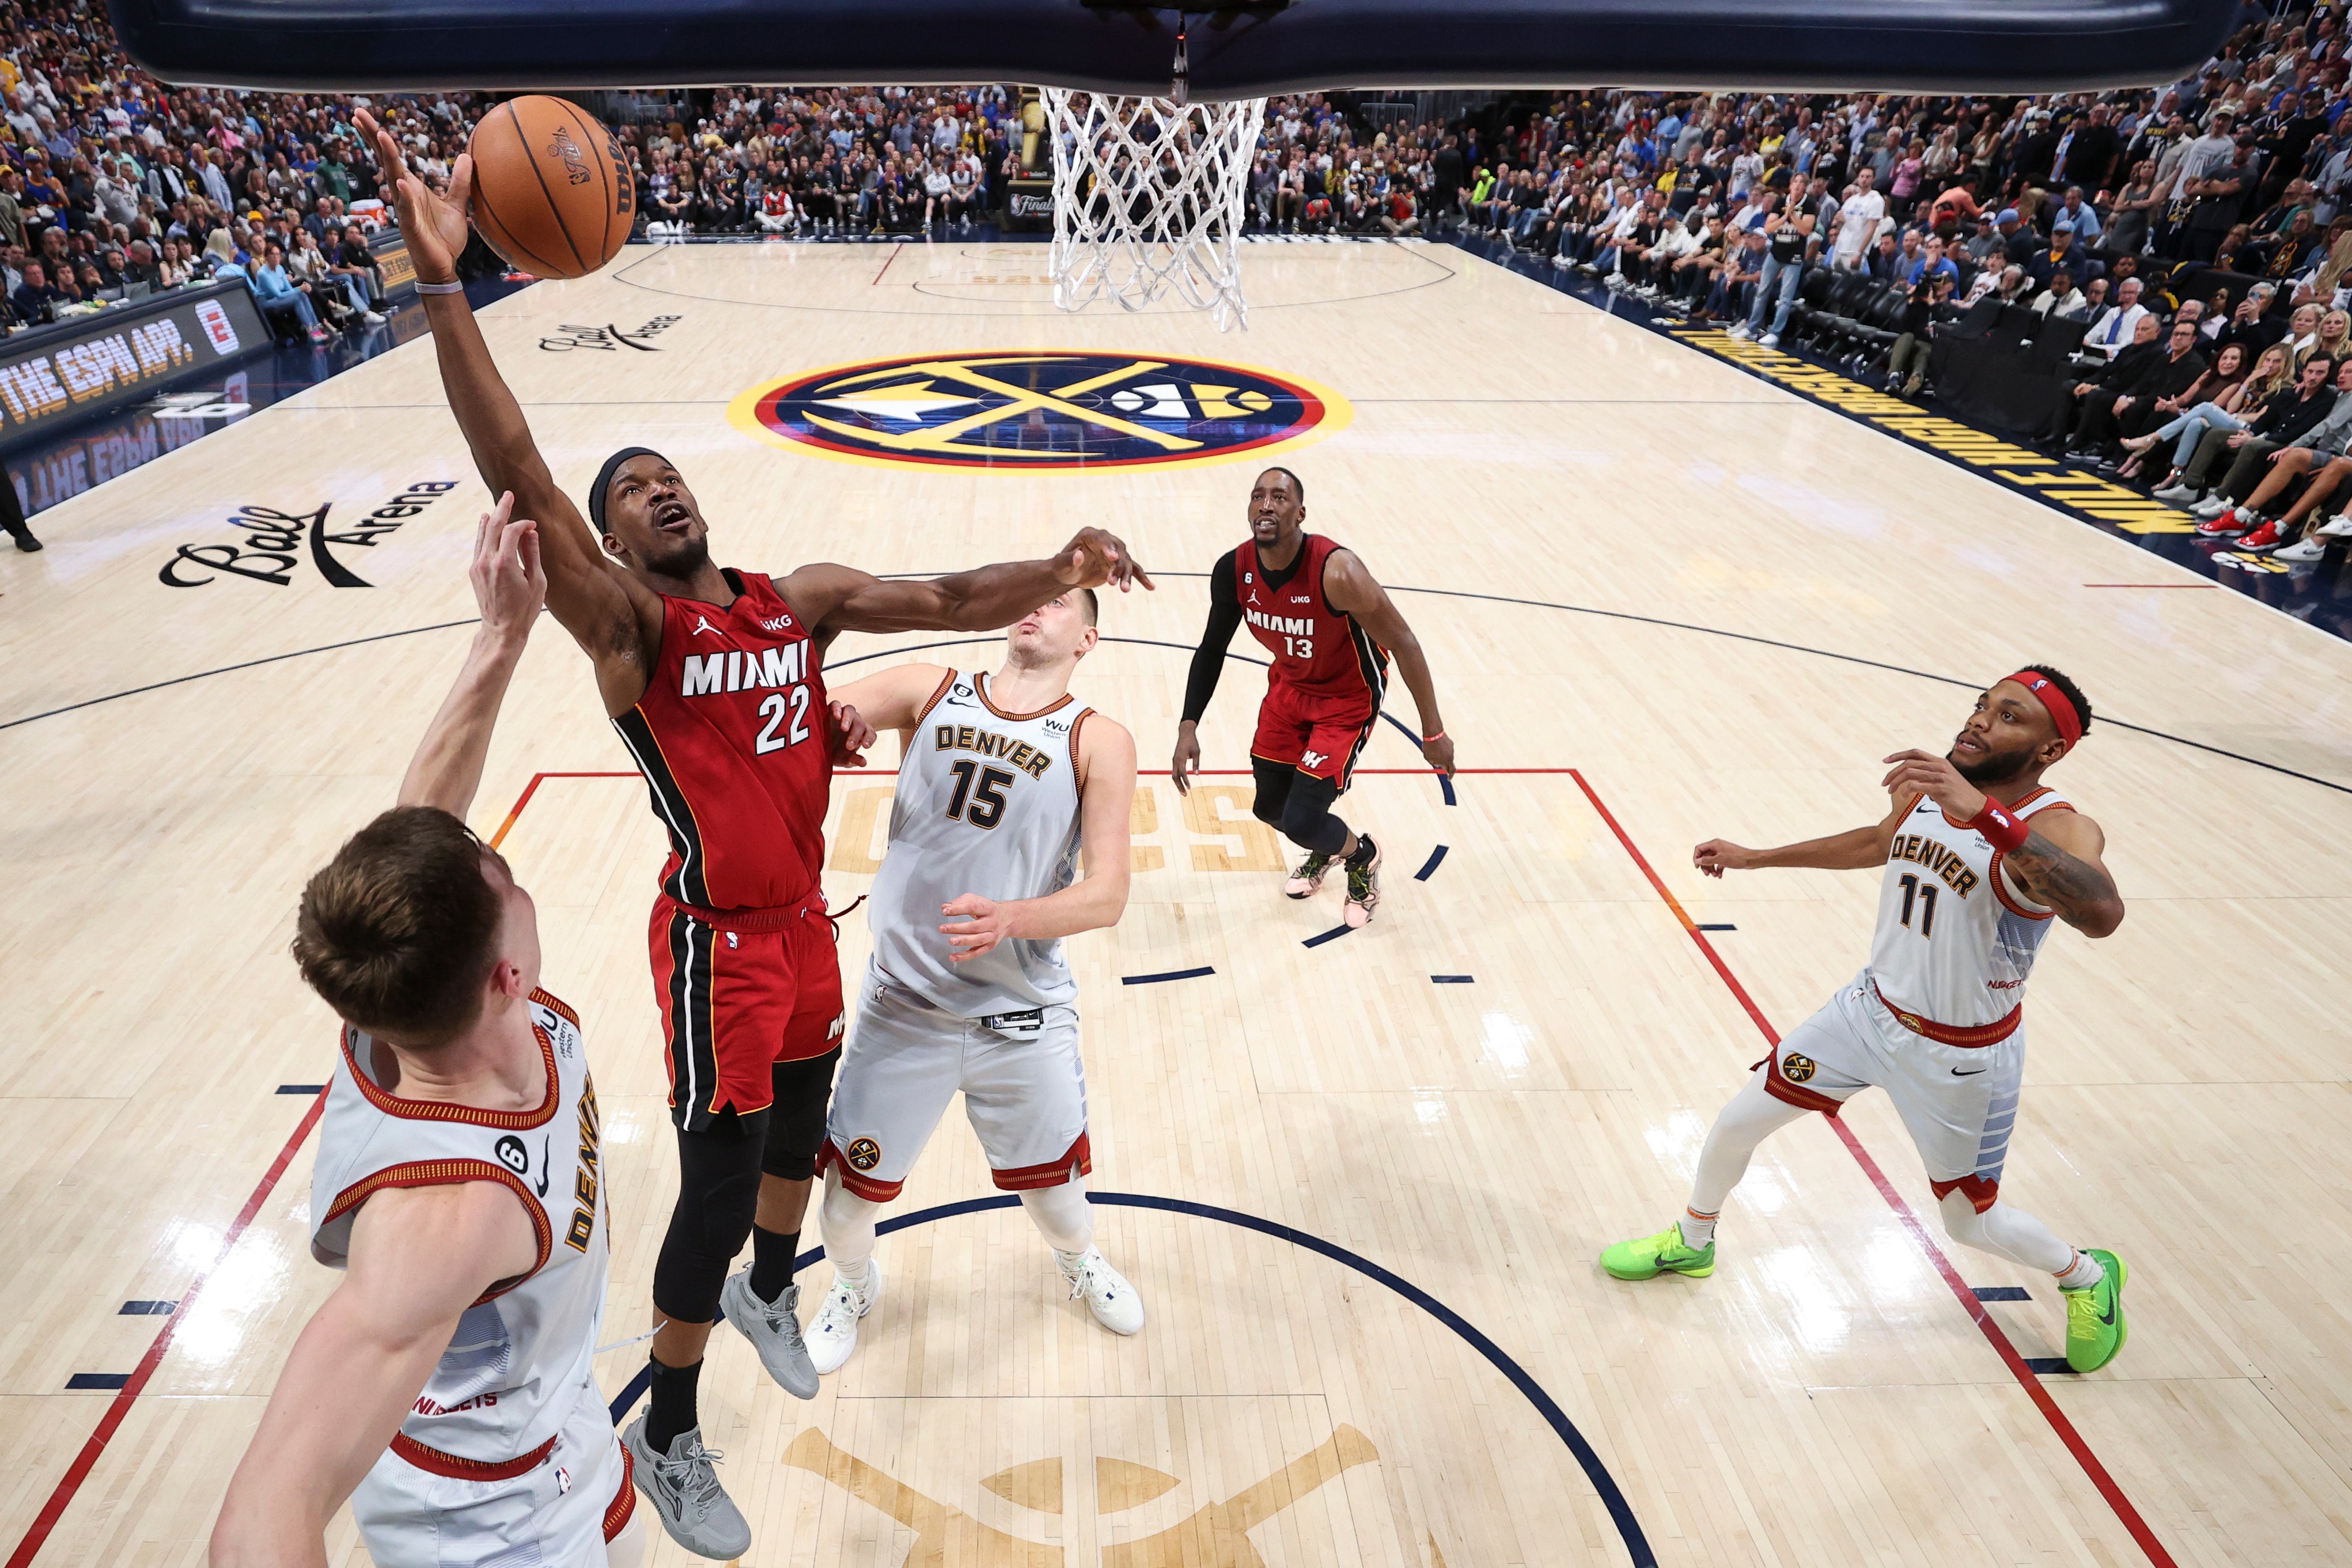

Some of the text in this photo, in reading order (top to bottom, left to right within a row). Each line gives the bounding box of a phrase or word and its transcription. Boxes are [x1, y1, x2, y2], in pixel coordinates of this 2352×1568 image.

[0, 318, 194, 425] THE ESPN APP.
[1244, 572, 1252, 584] 6
[1246, 607, 1314, 636] MIAMI
[1284, 636, 1313, 659] 13
[681, 638, 809, 696] MIAMI
[755, 683, 810, 756] 22
[1041, 726, 1066, 736] Western
[1046, 719, 1070, 732] WU
[936, 724, 1052, 781] DENVER
[946, 759, 1015, 830] 15
[1974, 842, 1990, 851] Union
[1891, 834, 1979, 899] DENVER
[1899, 873, 1939, 940] 11
[539, 1008, 558, 1041] U
[565, 1033, 573, 1058] Union
[499, 1142, 525, 1170] 6
